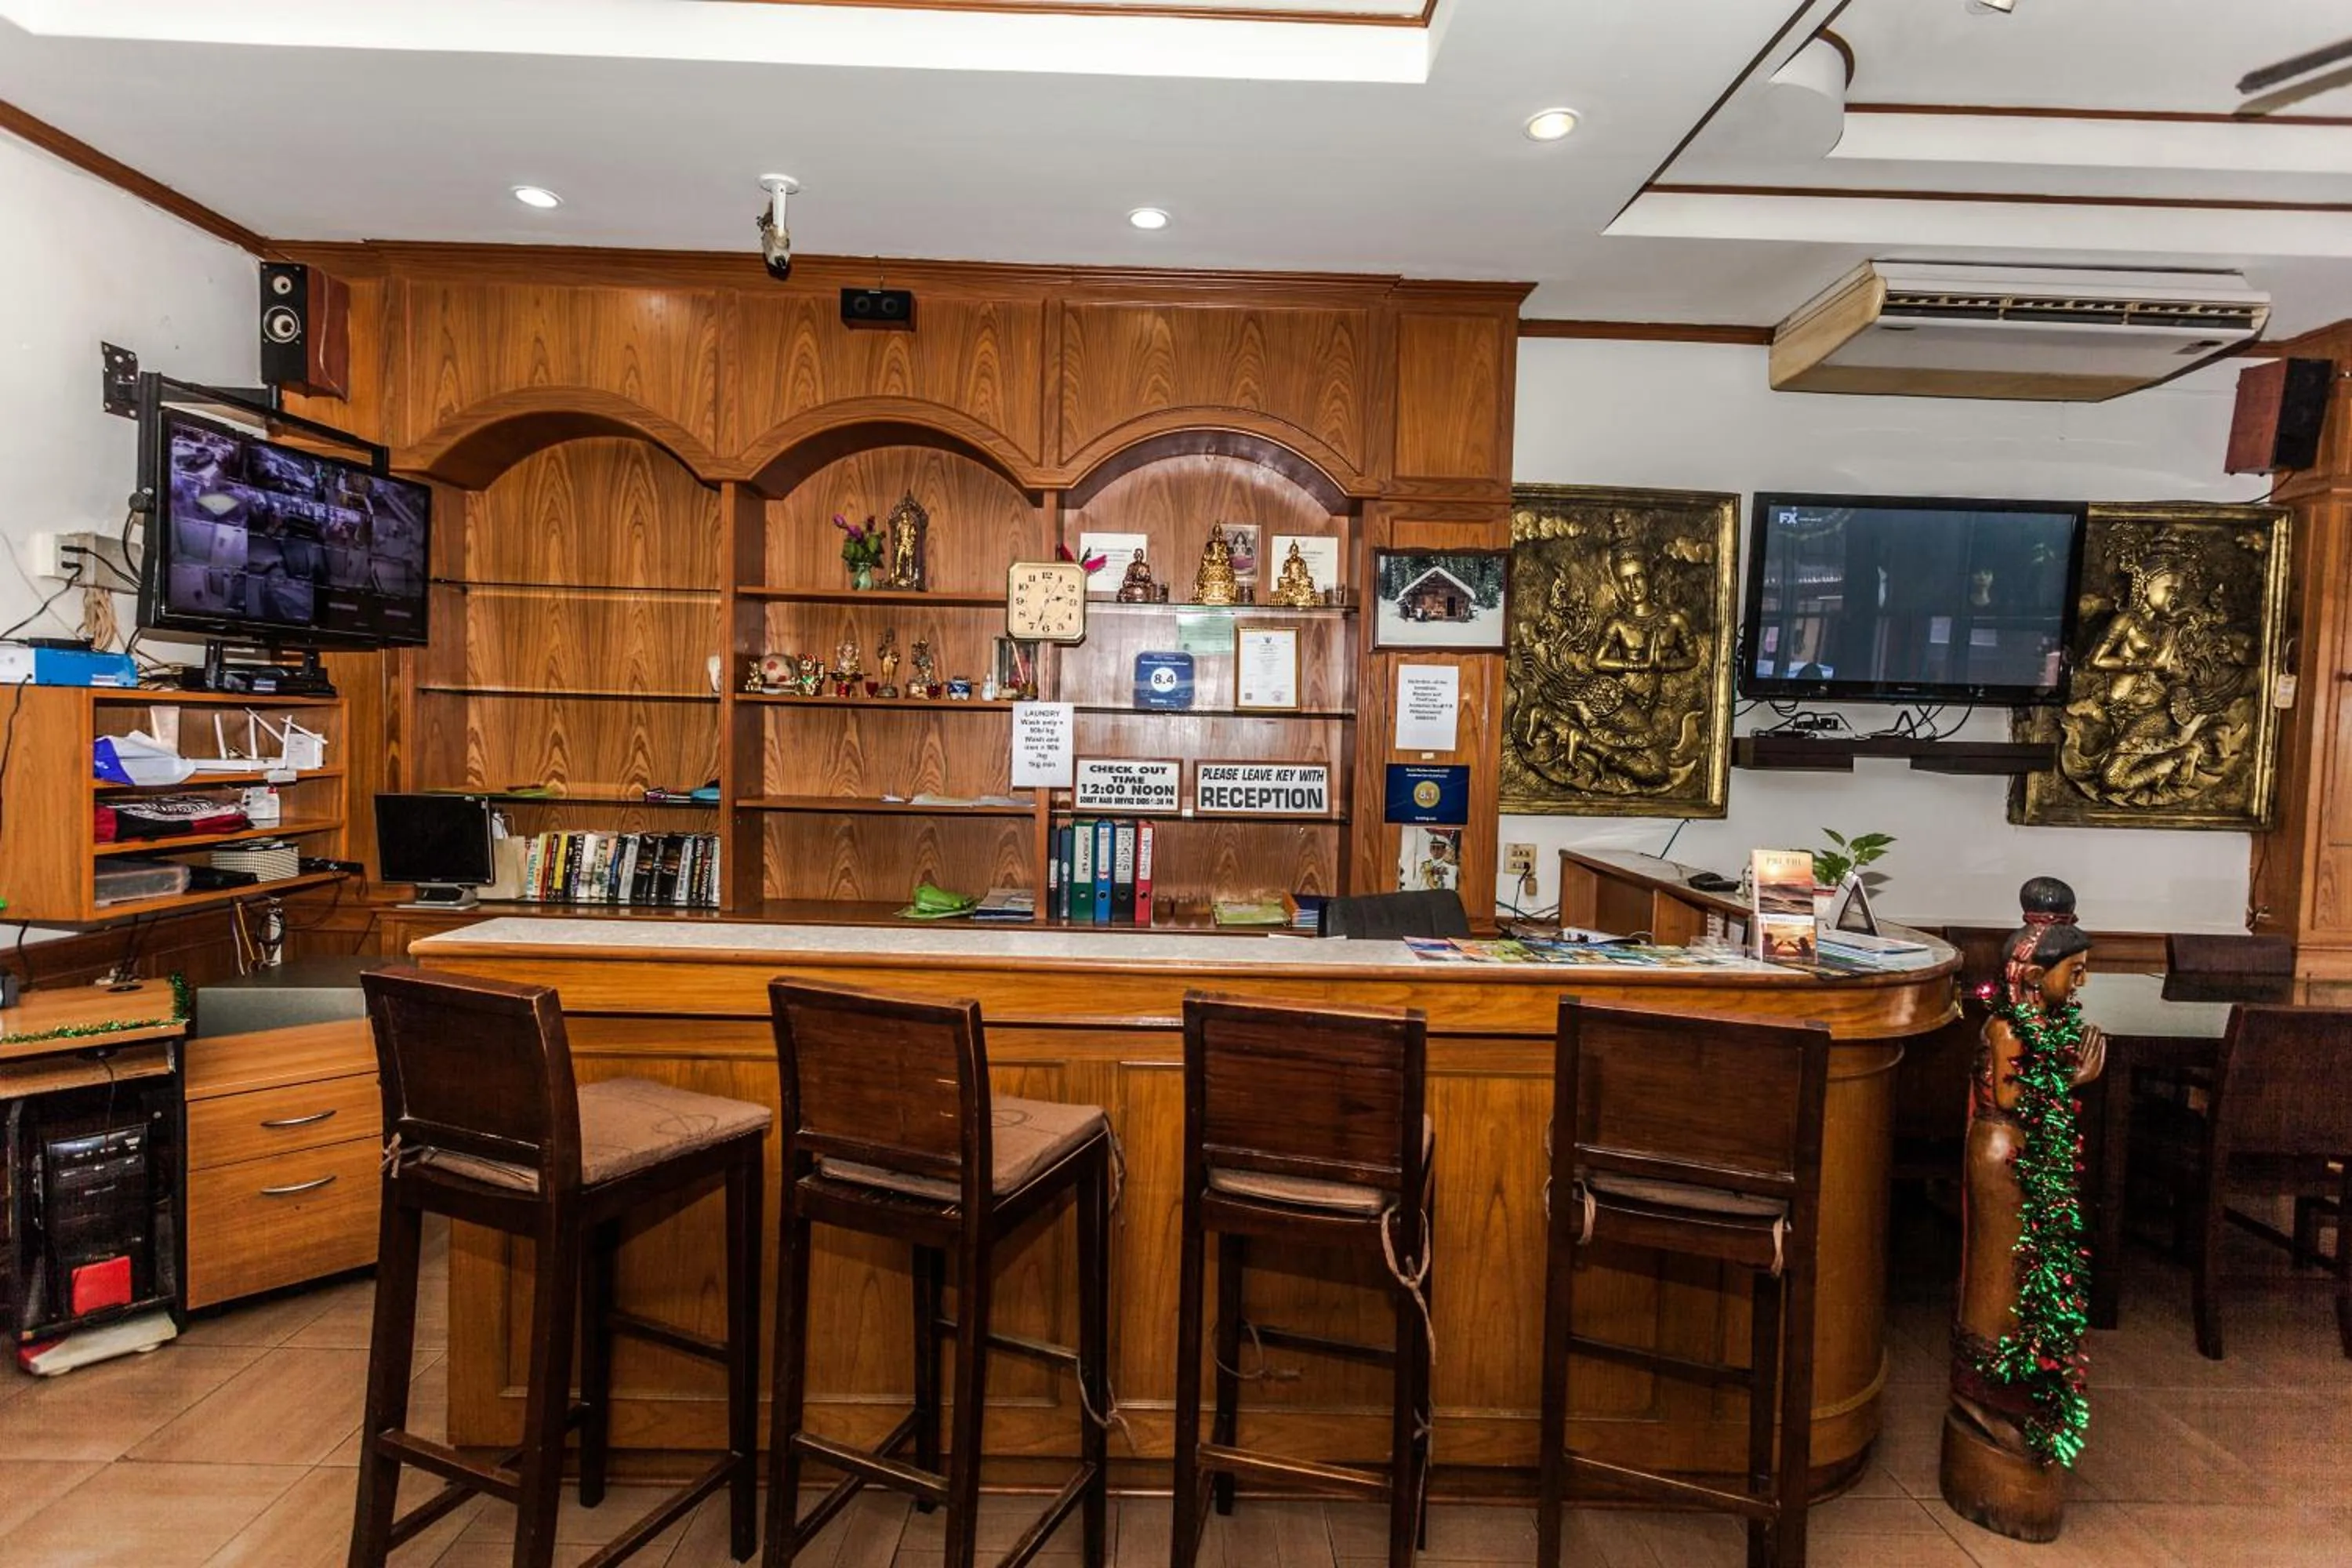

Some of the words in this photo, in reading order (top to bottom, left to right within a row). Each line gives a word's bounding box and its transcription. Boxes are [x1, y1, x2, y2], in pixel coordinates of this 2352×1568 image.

[1780, 512, 1798, 524] FX
[1154, 673, 1174, 684] 8.4
[1089, 765, 1133, 774] CHECK
[1138, 766, 1167, 775] OUT
[1202, 768, 1239, 781] PLEASE
[1242, 768, 1273, 781] LEAVE
[1276, 769, 1296, 782] KEY
[1299, 770, 1324, 782] WITH
[1081, 784, 1125, 794] 12:00
[1131, 785, 1174, 796] NOON
[1200, 786, 1323, 810] RECEPTION
